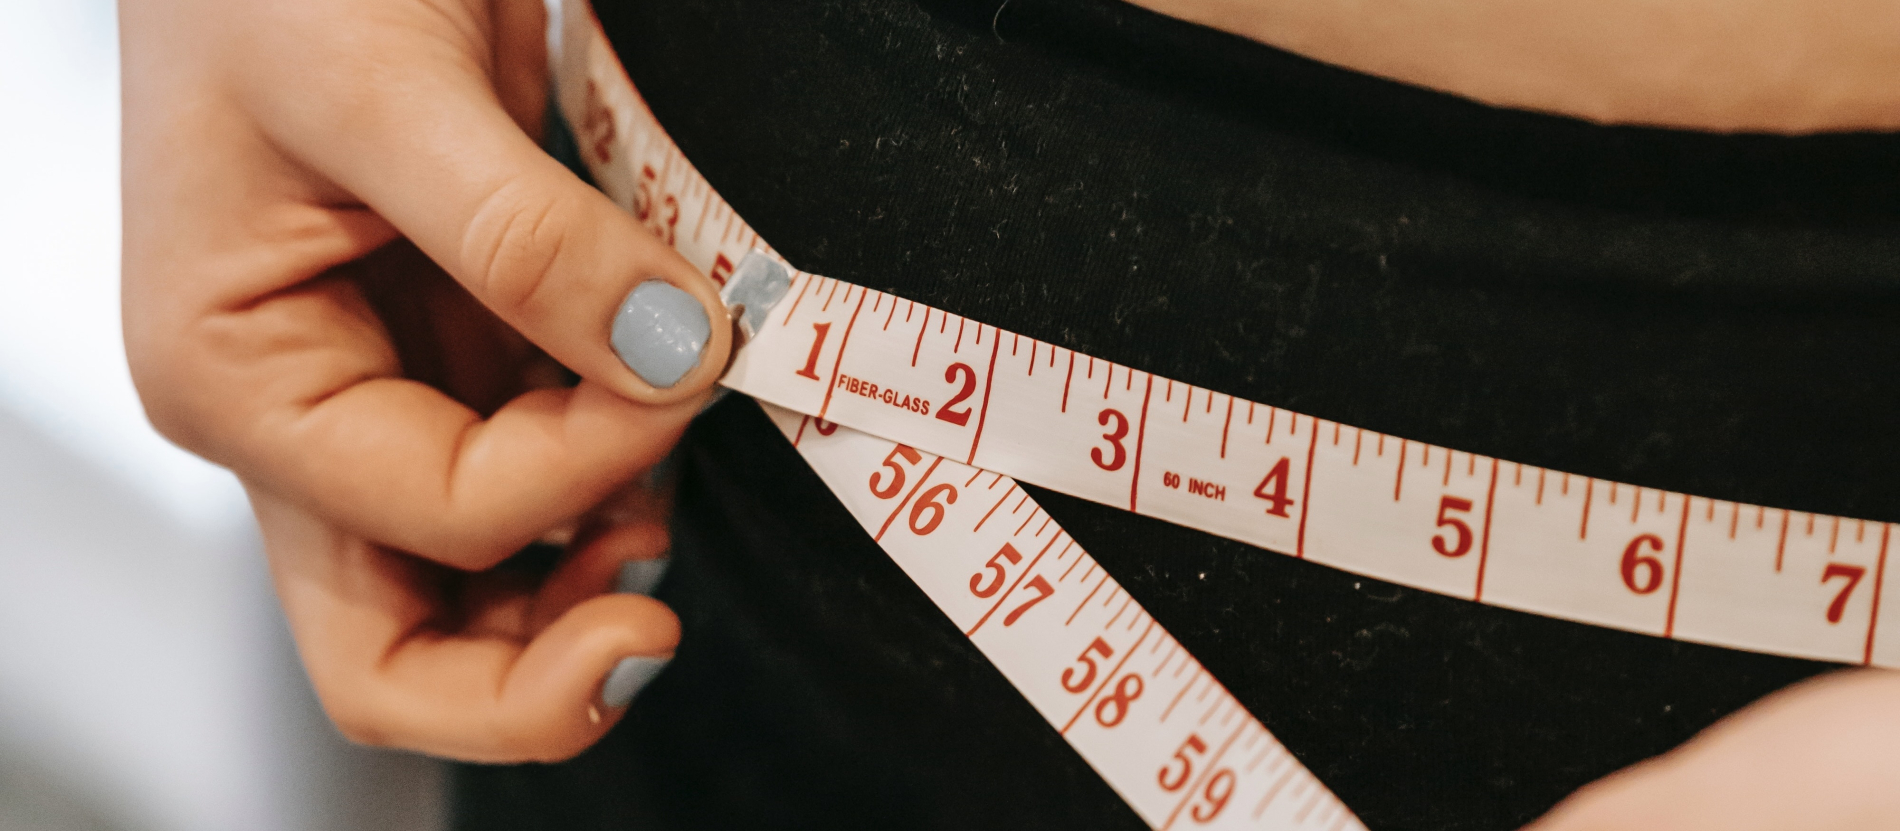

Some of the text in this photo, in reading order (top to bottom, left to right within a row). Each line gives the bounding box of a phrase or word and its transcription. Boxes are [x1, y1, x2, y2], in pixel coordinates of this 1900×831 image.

[795, 321, 832, 381] 1
[838, 374, 930, 415] FIBER-GLASS
[935, 362, 977, 426] 2
[1090, 408, 1129, 471] 3
[869, 443, 958, 536] 56
[1163, 471, 1226, 501] 60 INCH
[1253, 456, 1294, 519] 4
[1431, 494, 1474, 558] 5
[969, 542, 1055, 627] 57
[1620, 533, 1664, 595] 6
[1821, 562, 1867, 624] 7
[1060, 636, 1144, 728] 58
[1157, 732, 1237, 825] 59
